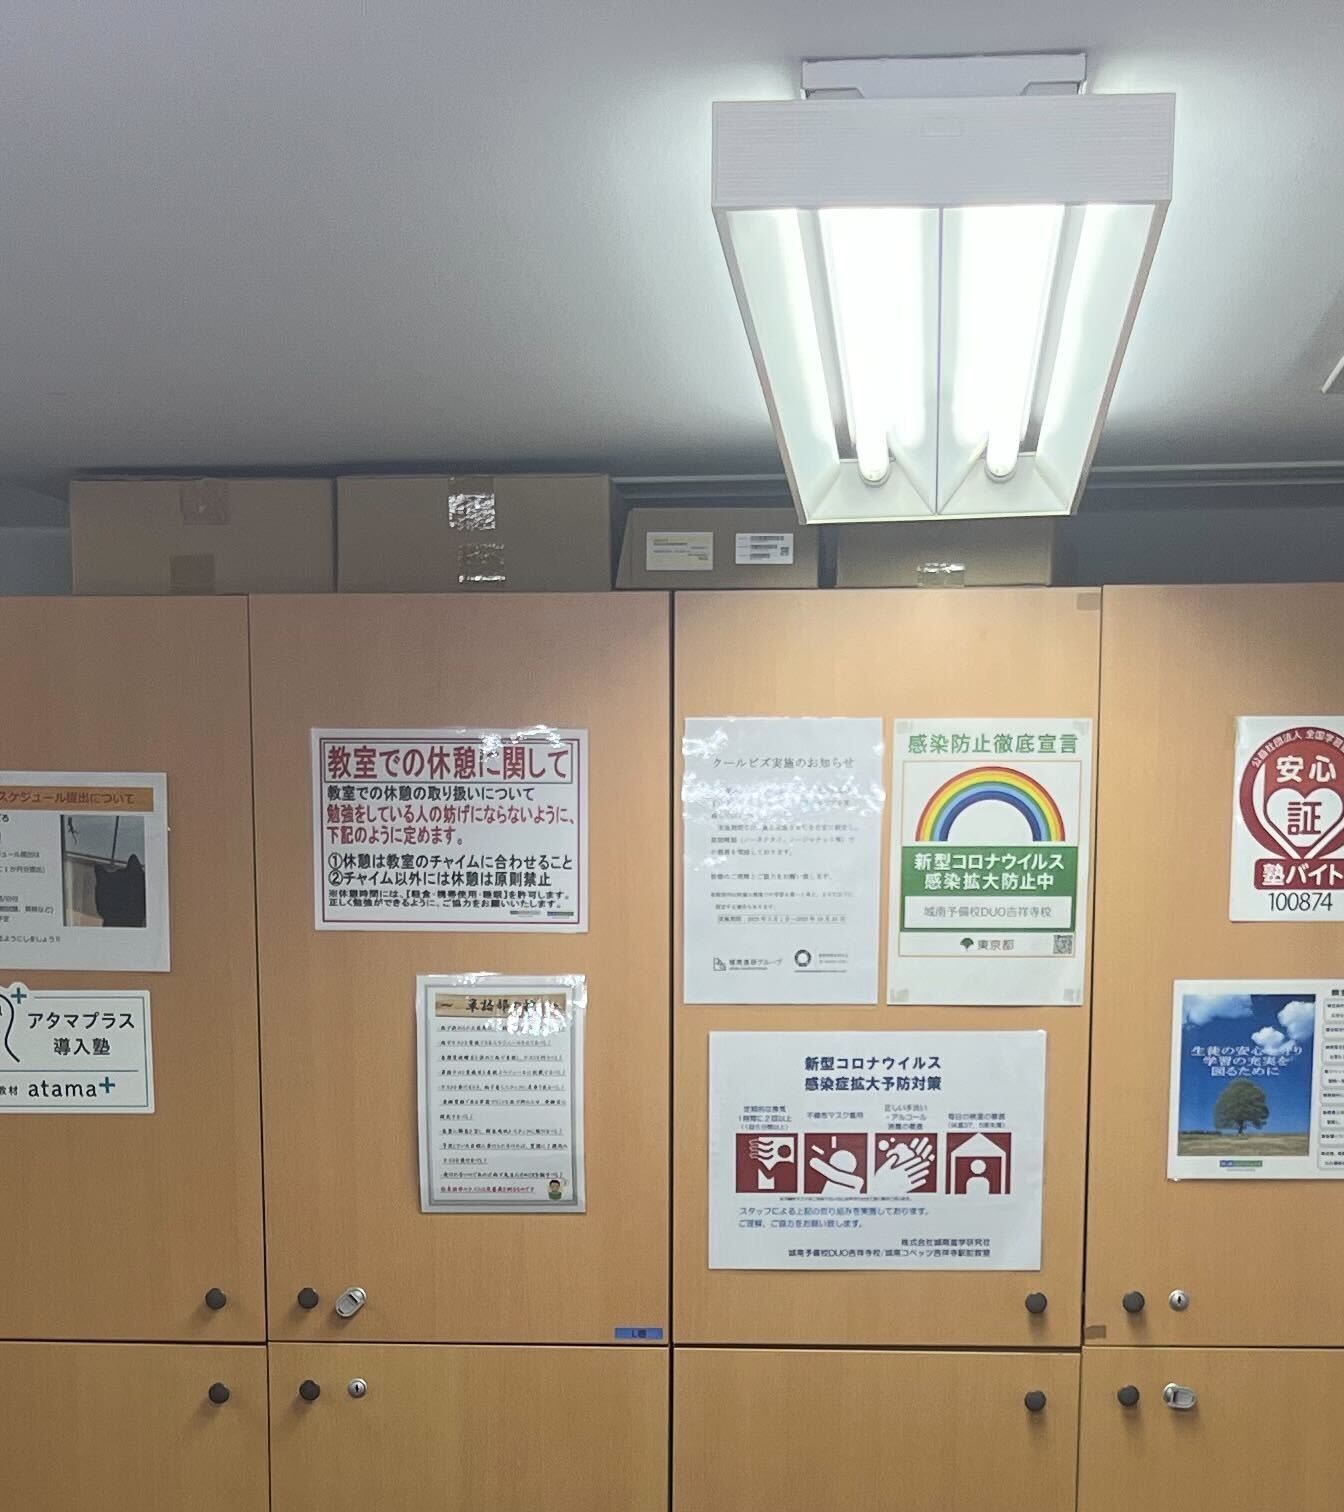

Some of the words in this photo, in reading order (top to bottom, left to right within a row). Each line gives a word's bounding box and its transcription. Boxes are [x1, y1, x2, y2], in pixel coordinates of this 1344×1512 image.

[908, 734, 1078, 754] 感染防止徹底宣言
[328, 746, 568, 779] 教室での休憩に関して
[712, 757, 856, 769] クールビズ実施のお知らせ
[1275, 755, 1336, 785] 安心
[328, 786, 534, 802] 教室での休憩の取り扱いについて
[327, 806, 575, 824] 勉強をしている人の妨げにならないように、
[1287, 802, 1322, 836] 証
[327, 827, 463, 845] 下記のように定めます。
[328, 852, 572, 870] ①休憩は教室のチャイムに合わせること
[915, 853, 1064, 871] 新型コロナウイルス
[328, 870, 551, 887] ②チャイム以外には休憩は原則禁止
[924, 872, 1053, 890] 感染拡大防止中
[1262, 863, 1344, 886] 塾バイト
[1268, 892, 1333, 912] 100874
[924, 906, 1052, 917] 城南予備校DUO吉祥寺校
[978, 939, 1014, 950] 東京都
[28, 1011, 135, 1031] アタマプラス
[53, 1038, 111, 1056] 導入塾
[805, 1056, 941, 1071] 新型コロナウイルス
[1211, 1067, 1280, 1076] 図るために
[805, 1076, 942, 1091] 感染症拡大予防対策
